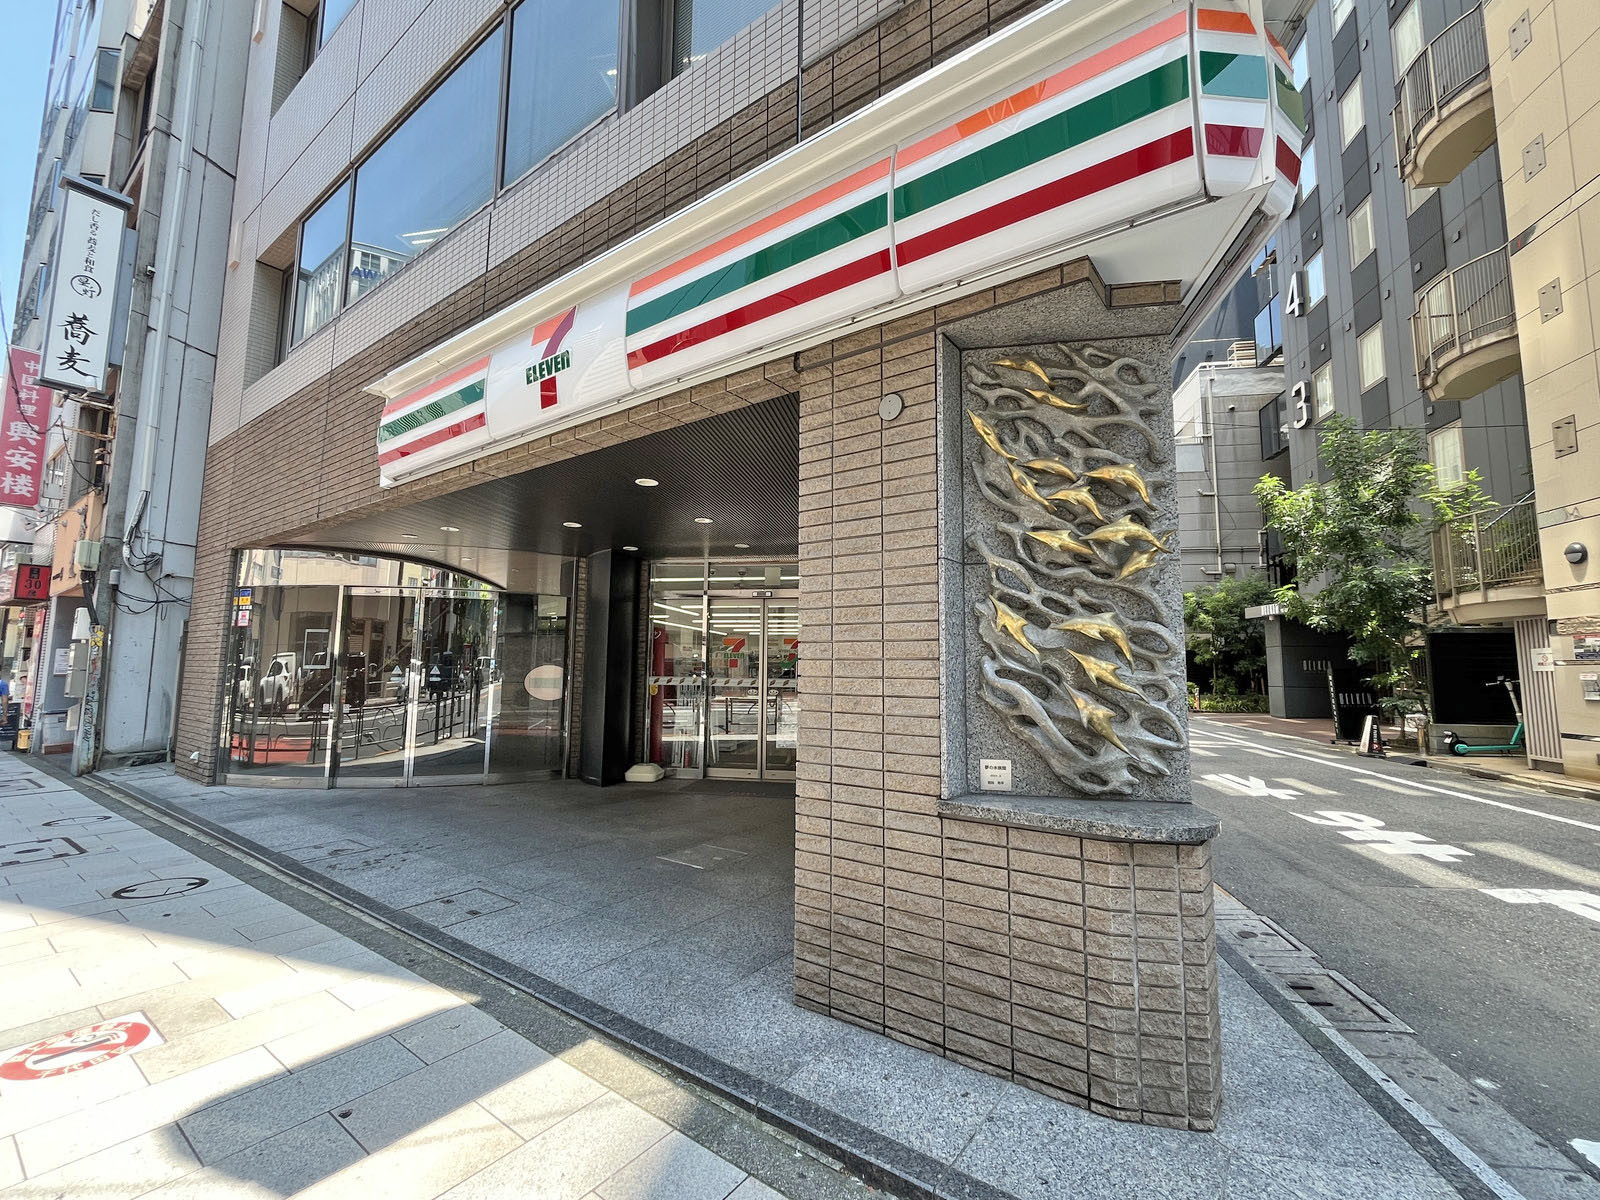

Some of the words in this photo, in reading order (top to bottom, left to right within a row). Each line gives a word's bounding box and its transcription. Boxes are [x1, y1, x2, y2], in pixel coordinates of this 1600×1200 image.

[1286, 271, 1304, 317] 4
[57, 312, 99, 377] 蕎麦
[17, 360, 40, 417] 中国料理
[1292, 380, 1308, 429] 3
